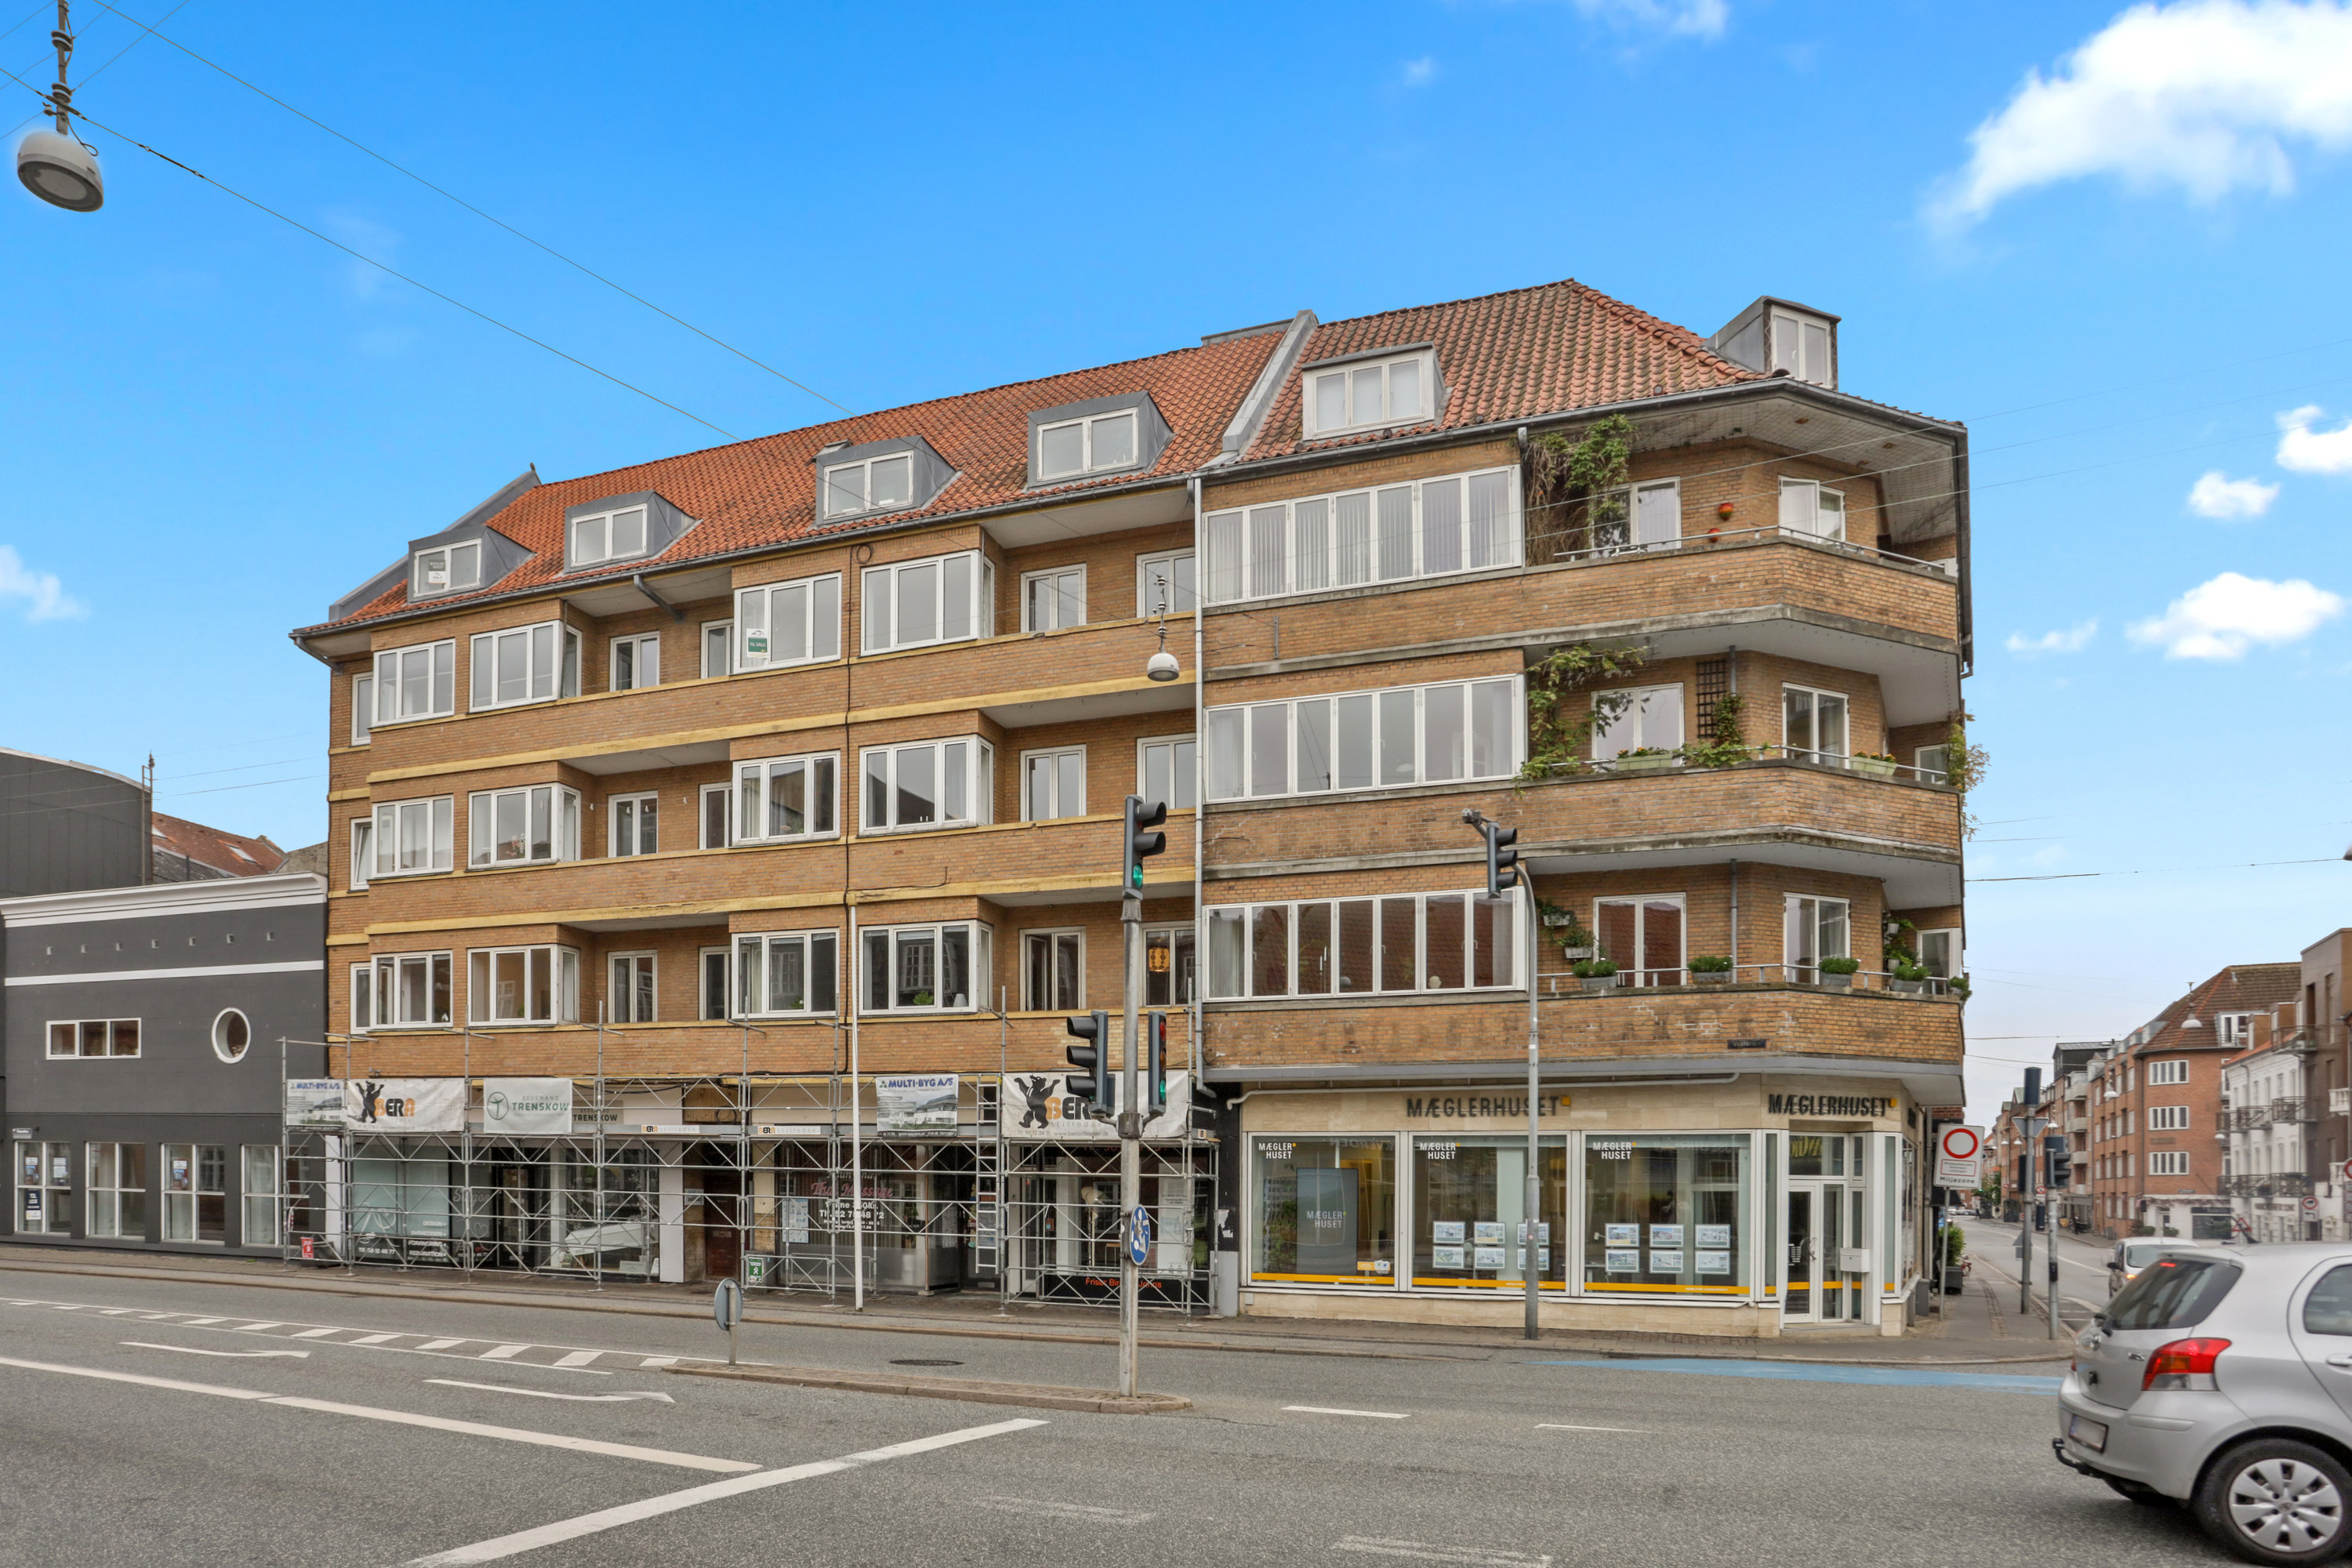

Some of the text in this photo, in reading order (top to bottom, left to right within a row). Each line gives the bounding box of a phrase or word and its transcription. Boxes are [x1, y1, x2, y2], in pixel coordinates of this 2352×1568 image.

[937, 1078, 953, 1087] A/S
[374, 1098, 416, 1117] BERA
[512, 1102, 569, 1111] TRENSKOW
[1044, 1097, 1092, 1120] BER
[1769, 1094, 1890, 1117] MÆGLERHUSET
[1258, 1142, 1292, 1151] MÆGLER
[1420, 1142, 1456, 1151] MÆGLER
[1593, 1142, 1632, 1151] MÆGLER
[1266, 1151, 1292, 1160] HUSET
[1428, 1151, 1456, 1160] HUSET
[1601, 1151, 1632, 1160] HUSET
[840, 1183, 893, 1199] Mssage
[1306, 1210, 1343, 1219] MÆGLER
[1315, 1220, 1343, 1229] HUSET
